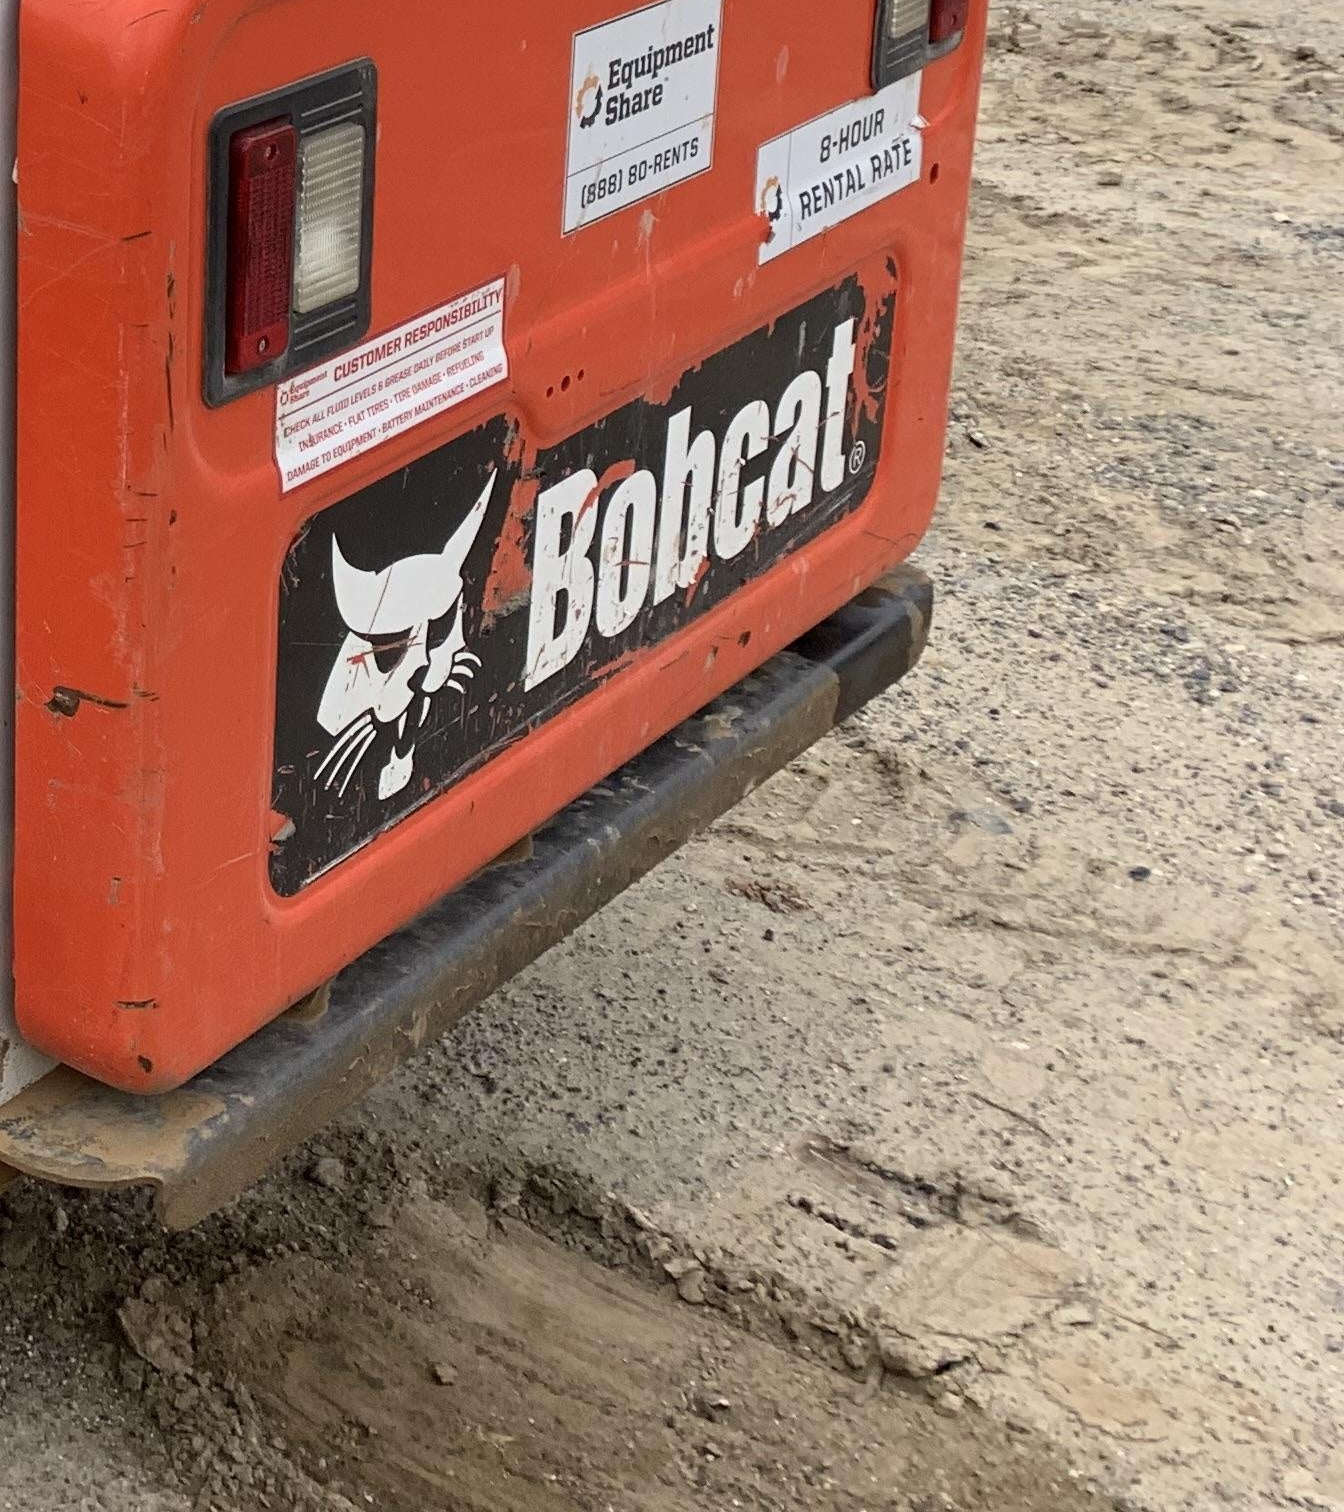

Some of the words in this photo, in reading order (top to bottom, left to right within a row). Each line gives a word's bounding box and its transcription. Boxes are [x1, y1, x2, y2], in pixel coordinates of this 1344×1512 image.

[607, 23, 715, 91] Equipment
[604, 81, 664, 126] Share
[819, 108, 885, 164] 8-HOUR
[580, 168, 623, 209] (888)
[627, 136, 700, 187] 80-RENTS
[798, 163, 867, 221] RENTAL
[870, 137, 913, 183] RATE
[334, 336, 402, 383] CUSTOMER
[404, 287, 503, 348] RESPONSIBILITY
[283, 418, 311, 438] CHECK
[312, 411, 326, 425] ALL
[326, 397, 350, 417] FLUID
[350, 385, 376, 406] LEVELS
[384, 367, 411, 388] GREASE
[413, 354, 434, 374] DAILY
[435, 341, 462, 363] BEFORE
[462, 333, 483, 349] START
[484, 326, 495, 338] UP
[287, 458, 320, 482] DAMAGE
[321, 452, 332, 464] TO
[333, 428, 377, 459] EQUIPMENT
[382, 411, 414, 434] BATTERY
[414, 382, 465, 416] MAINTENANCE
[469, 363, 503, 387] CLEANING
[298, 421, 343, 452] INSURANCE
[348, 412, 366, 427] FLAT
[366, 399, 390, 418] TIRES
[393, 386, 411, 404] TIRE
[413, 372, 442, 395] DAMAGE
[446, 351, 485, 377] REFUELING
[523, 315, 858, 693] Bobcat
